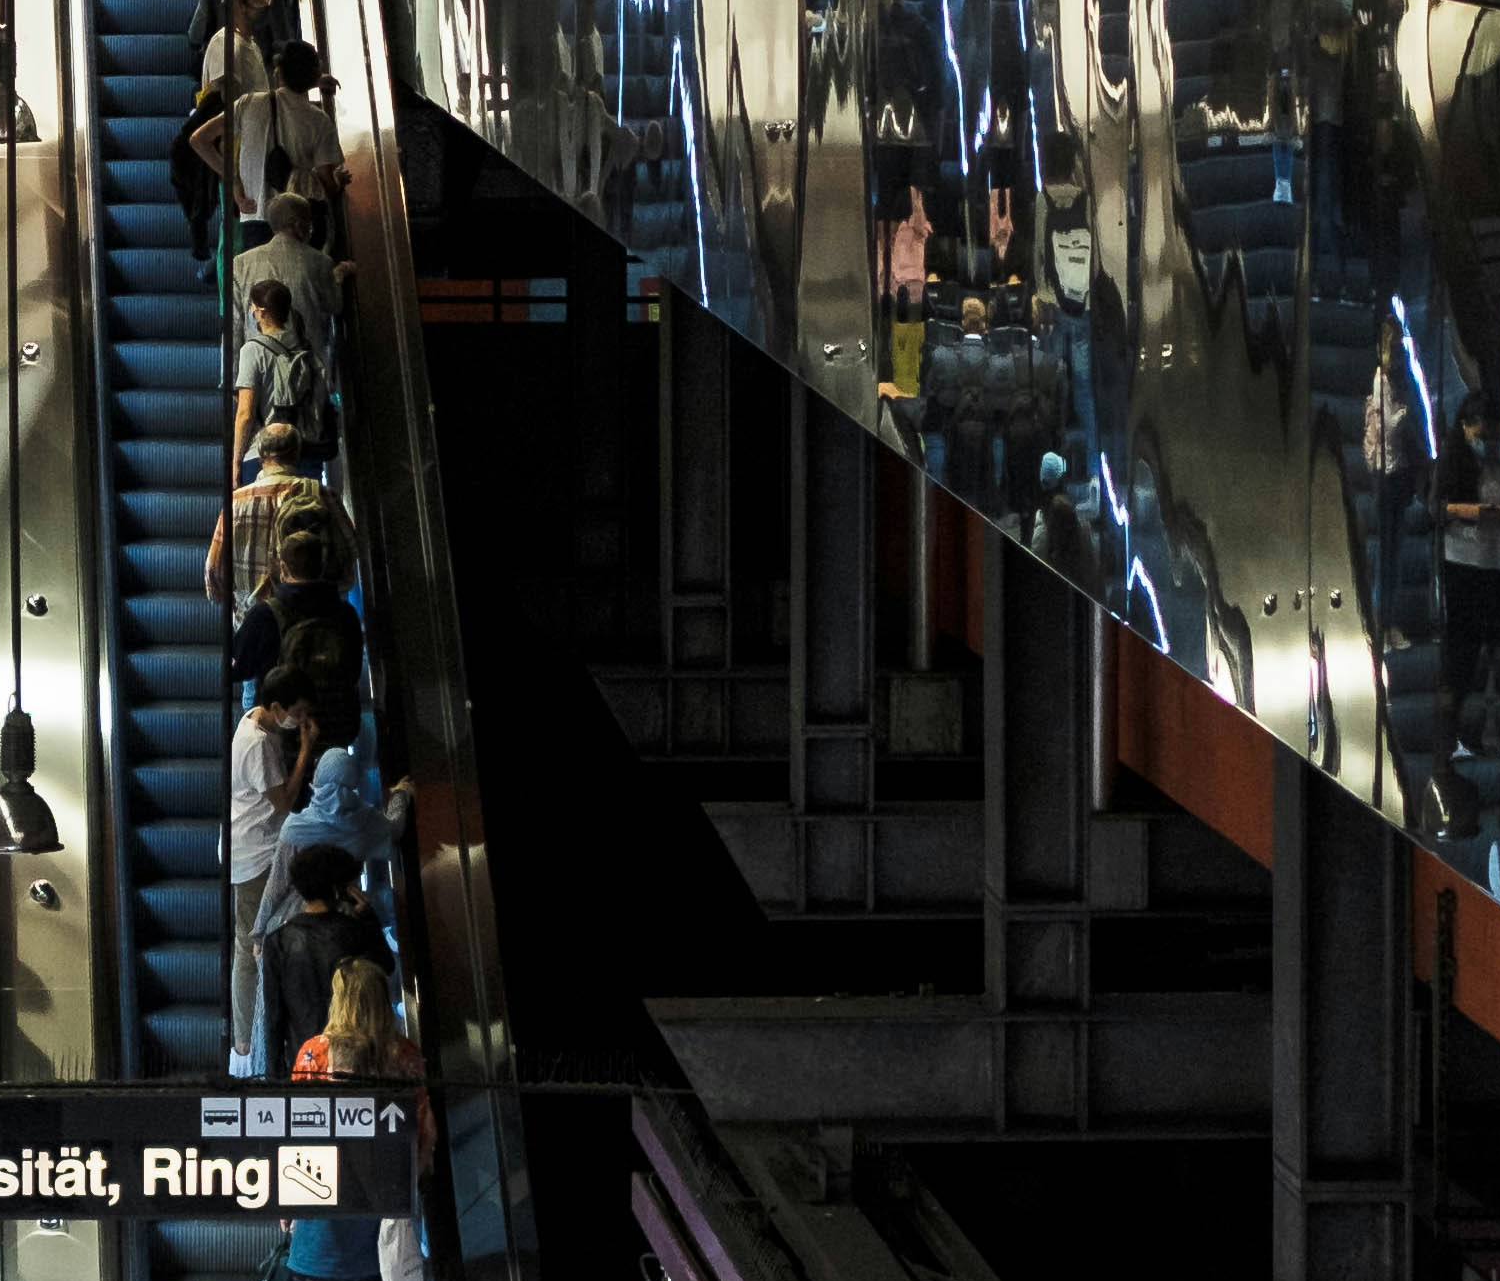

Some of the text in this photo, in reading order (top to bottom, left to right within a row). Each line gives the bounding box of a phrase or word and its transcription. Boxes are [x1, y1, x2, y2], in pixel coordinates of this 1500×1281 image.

[257, 1110, 274, 1124] 1A
[338, 1107, 373, 1126] WC
[143, 1146, 271, 1206] Ring
